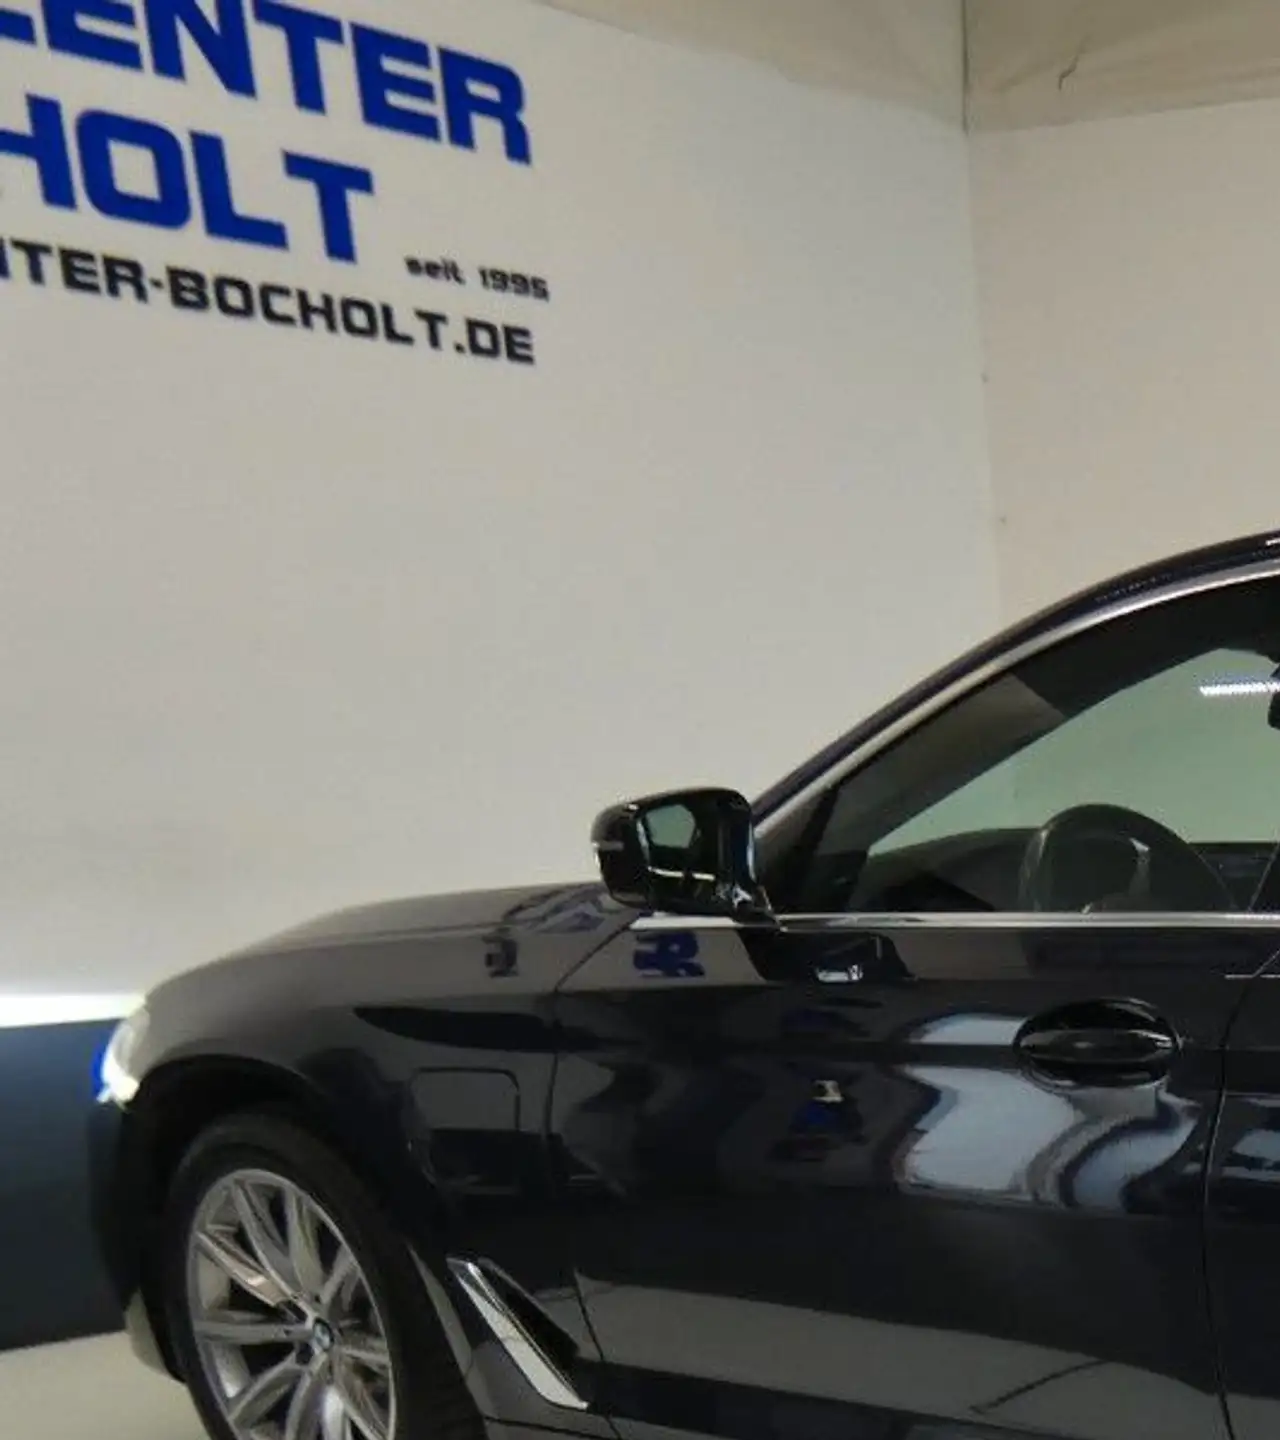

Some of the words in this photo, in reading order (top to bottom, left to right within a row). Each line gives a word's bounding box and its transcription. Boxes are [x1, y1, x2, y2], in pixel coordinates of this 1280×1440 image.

[0, 0, 531, 164] ENTER
[0, 236, 535, 366] TER-BOCHOLT.DE
[404, 255, 466, 286] seit
[478, 265, 550, 302] 1995
